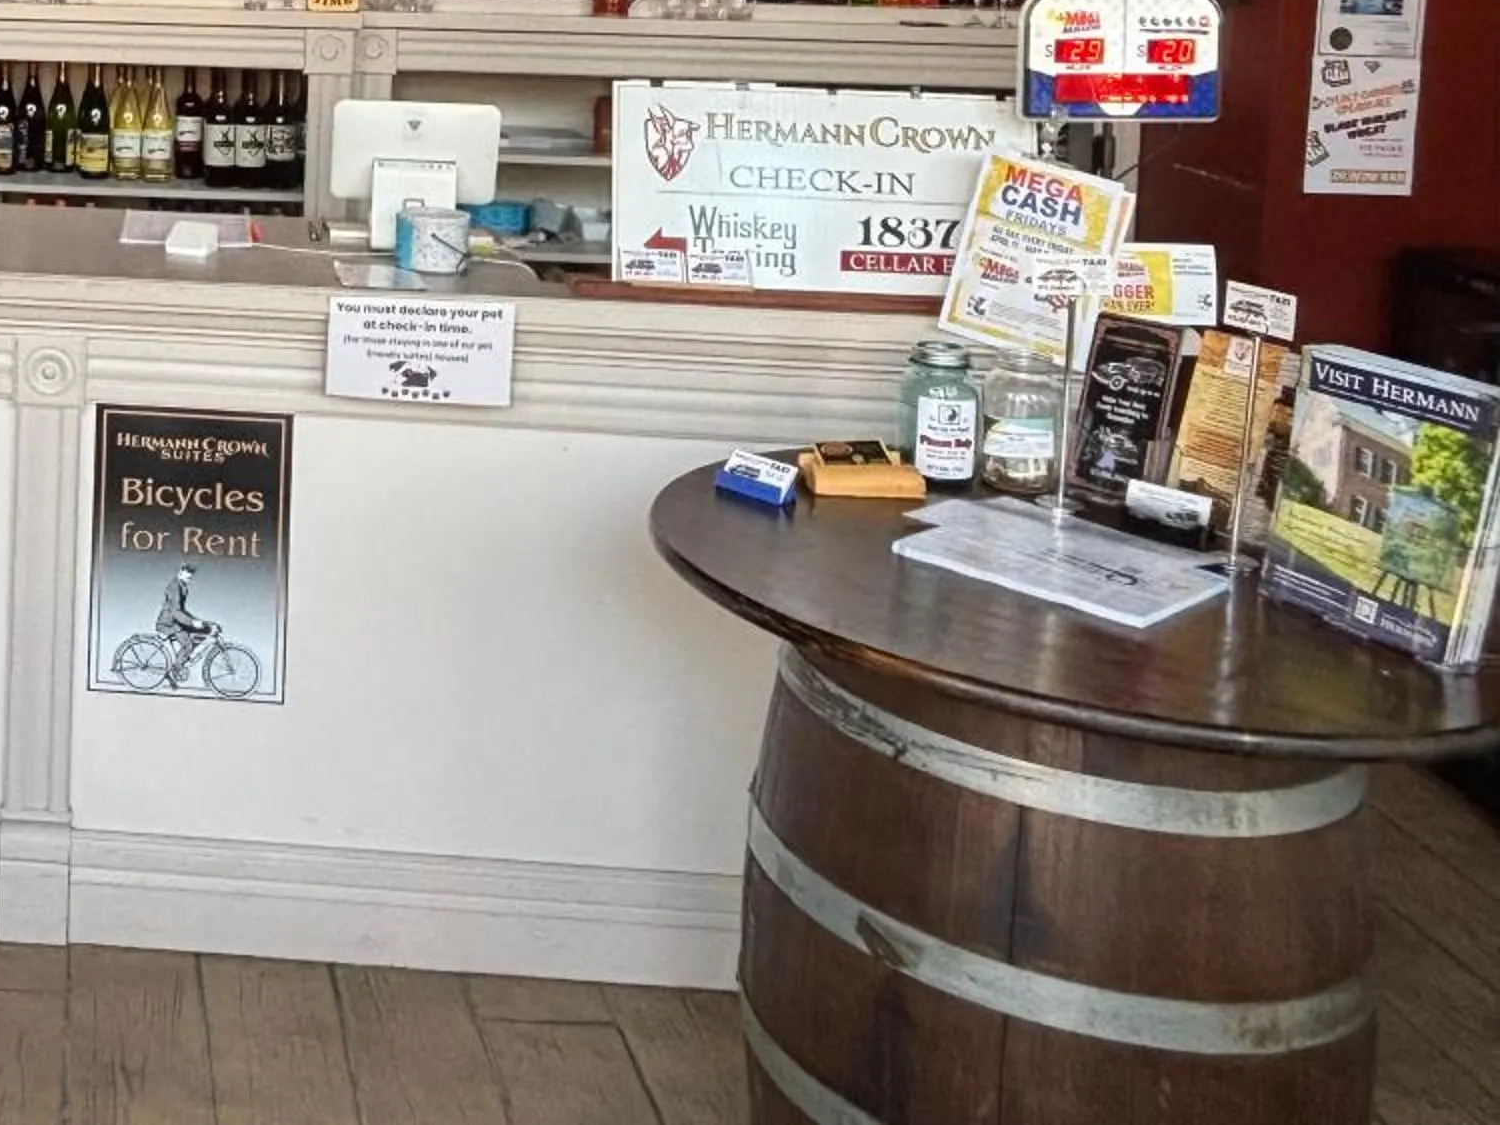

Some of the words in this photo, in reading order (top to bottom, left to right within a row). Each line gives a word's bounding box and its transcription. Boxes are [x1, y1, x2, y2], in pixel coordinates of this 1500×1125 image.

[728, 163, 916, 198] CHECK-IN
[1004, 164, 1086, 203] MEGA
[1001, 184, 1082, 227] CASH
[1004, 209, 1069, 236] FRIDAYS
[689, 204, 797, 249] Whiskey
[857, 216, 960, 249] 1837
[693, 236, 797, 277] Ting
[850, 253, 935, 272] CELLAR
[1113, 284, 1155, 300] GGER
[337, 302, 361, 313] You
[363, 304, 397, 315] must
[399, 305, 447, 317] declare
[450, 308, 479, 320] your
[481, 309, 504, 322] pet
[363, 321, 378, 330] at
[1315, 361, 1364, 391] VISIT
[1371, 377, 1480, 423] HERMANN
[161, 449, 226, 463] SUITES
[121, 477, 265, 515] Bicycles
[120, 520, 170, 551] for
[183, 527, 261, 558] Rent
